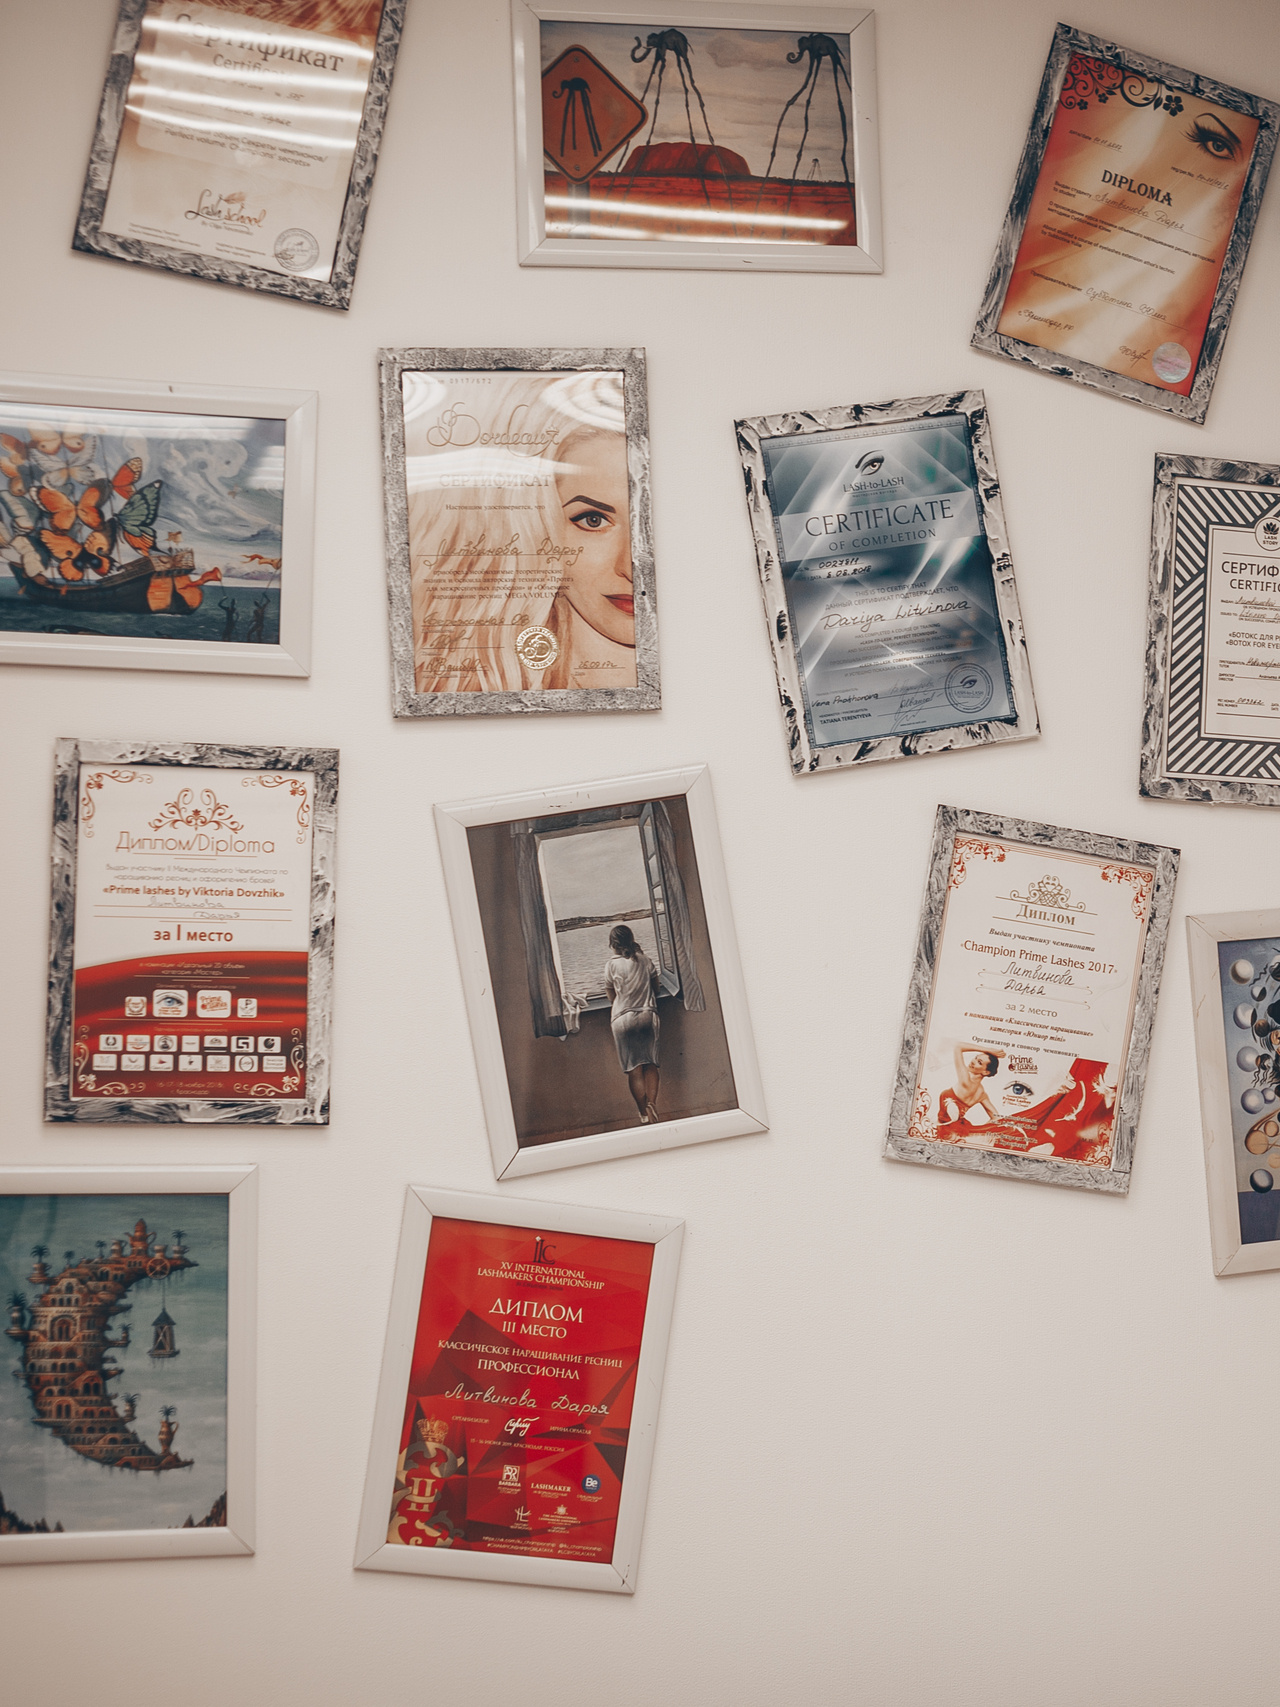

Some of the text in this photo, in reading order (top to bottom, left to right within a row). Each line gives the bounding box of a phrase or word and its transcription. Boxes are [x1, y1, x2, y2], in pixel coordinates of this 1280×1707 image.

[1100, 169, 1174, 207] DIPLOMA
[439, 473, 551, 489] СЕРТИФИКАТ
[843, 476, 904, 493] LASH-to-LASH
[804, 499, 954, 537] CERTIFICATE
[828, 528, 936, 551] OF COMPLETION
[887, 584, 910, 592] CERTIFY
[824, 600, 853, 610] ДАННЫЙ
[854, 594, 894, 605] СЕРТИФИКАТ
[895, 587, 945, 600] ПОДТВЕРЖДАЕТ,
[819, 595, 971, 638] Dariya Litvinova
[1225, 638, 1251, 647] «BOTOX
[1228, 630, 1258, 640] «БОТОКС
[1259, 633, 1273, 641] ДЛЯ
[115, 830, 274, 855] Диплом/Diploma
[102, 884, 285, 898] «Prime lashes by Viktoria Dovzhik»
[1016, 903, 1076, 928] Диплом
[153, 930, 171, 940] за
[186, 930, 233, 942] место
[988, 927, 1095, 952] Выдан участнику чемпионата
[1018, 948, 1048, 963] Prime
[1050, 953, 1085, 970] Lashes
[1000, 957, 1076, 986] Литвинова
[1003, 977, 1047, 999] Дарья
[1005, 1002, 1058, 1018] за 2 место
[968, 1011, 1004, 1023] номинации
[1004, 1016, 1049, 1030] «Классическое
[989, 1024, 1022, 1036] категория
[971, 1035, 1010, 1048] Организатор
[1016, 1043, 1040, 1053] спонсор
[1008, 1053, 1033, 1065] Prime
[476, 1267, 534, 1282] LASHMAKERS
[534, 1274, 605, 1290] CHAMPIONSHIP
[500, 1261, 586, 1279] XV INTERNATIONAL
[488, 1296, 585, 1324] ДИПЛОМ
[501, 1321, 567, 1339] III МЕСТО
[437, 1339, 510, 1355] КЛАССИЧЕСКОЕ
[583, 1355, 623, 1368] РЕСНИЦ
[477, 1358, 580, 1380] ПРОФЕССИОНАЛ
[443, 1379, 611, 1419] Литвинова Дарья
[530, 1482, 571, 1492] LASHMAKER
[584, 1477, 598, 1488] Be
